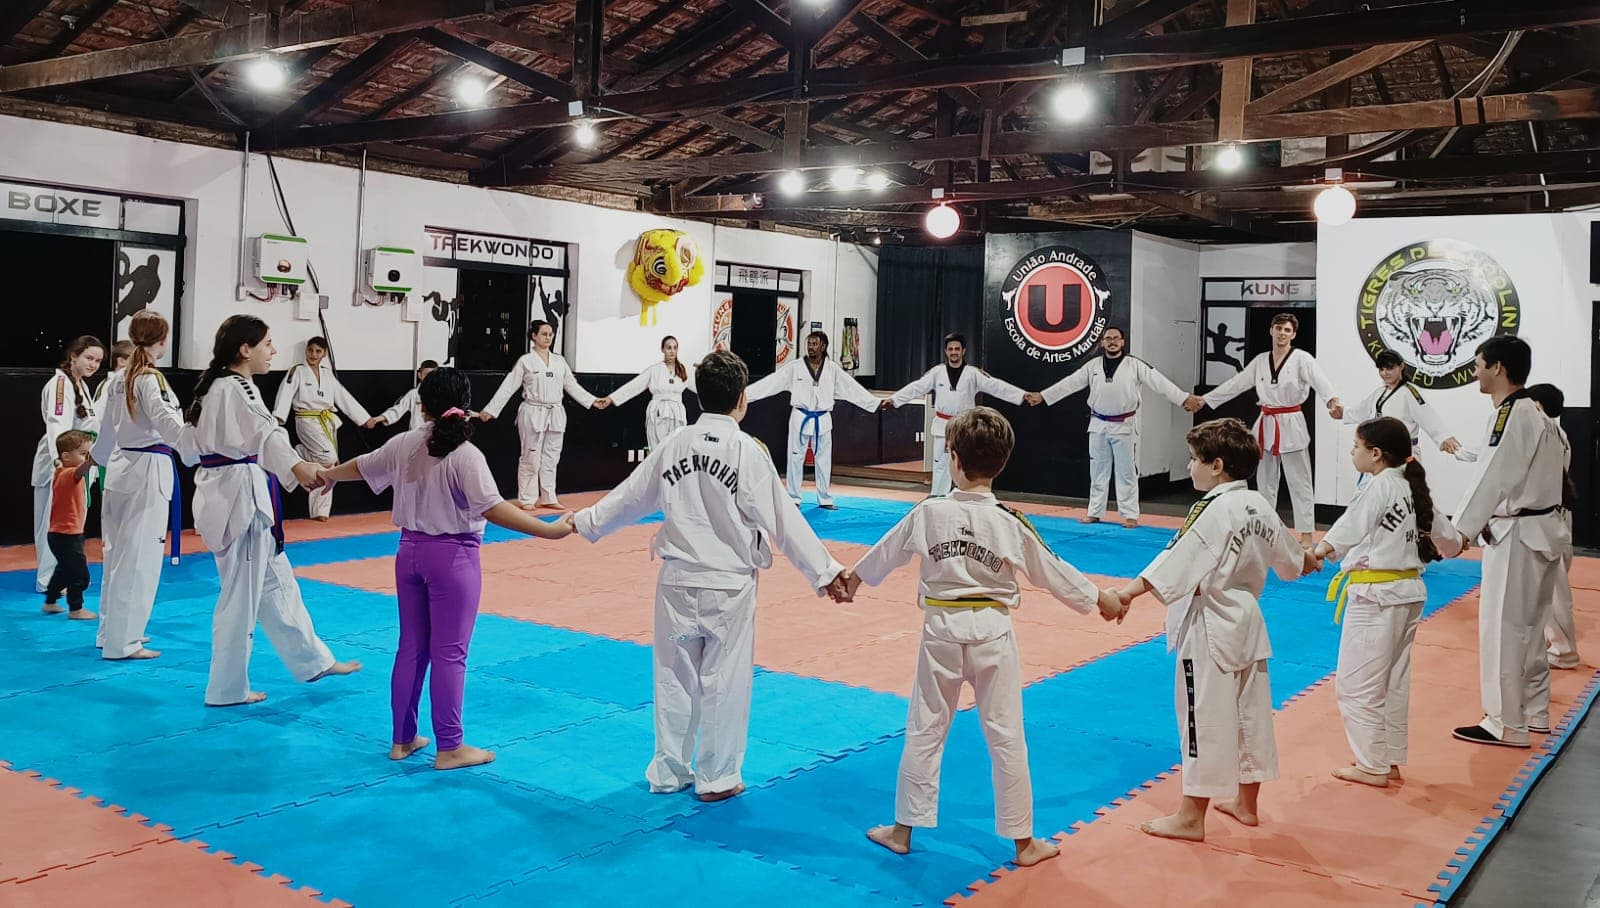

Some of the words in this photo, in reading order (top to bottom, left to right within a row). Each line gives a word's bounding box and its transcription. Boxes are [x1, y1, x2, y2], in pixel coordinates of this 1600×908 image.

[8, 191, 102, 217] BOXE
[430, 234, 554, 260] TAEKWONDO
[1013, 254, 1046, 282] União
[1049, 250, 1097, 281] Andrade
[1241, 278, 1301, 296] KUNG
[1360, 253, 1405, 330] TIGRES
[1028, 284, 1082, 333] U
[1004, 317, 1026, 351] Escola
[1026, 346, 1041, 359] de
[1042, 351, 1071, 363] Artes
